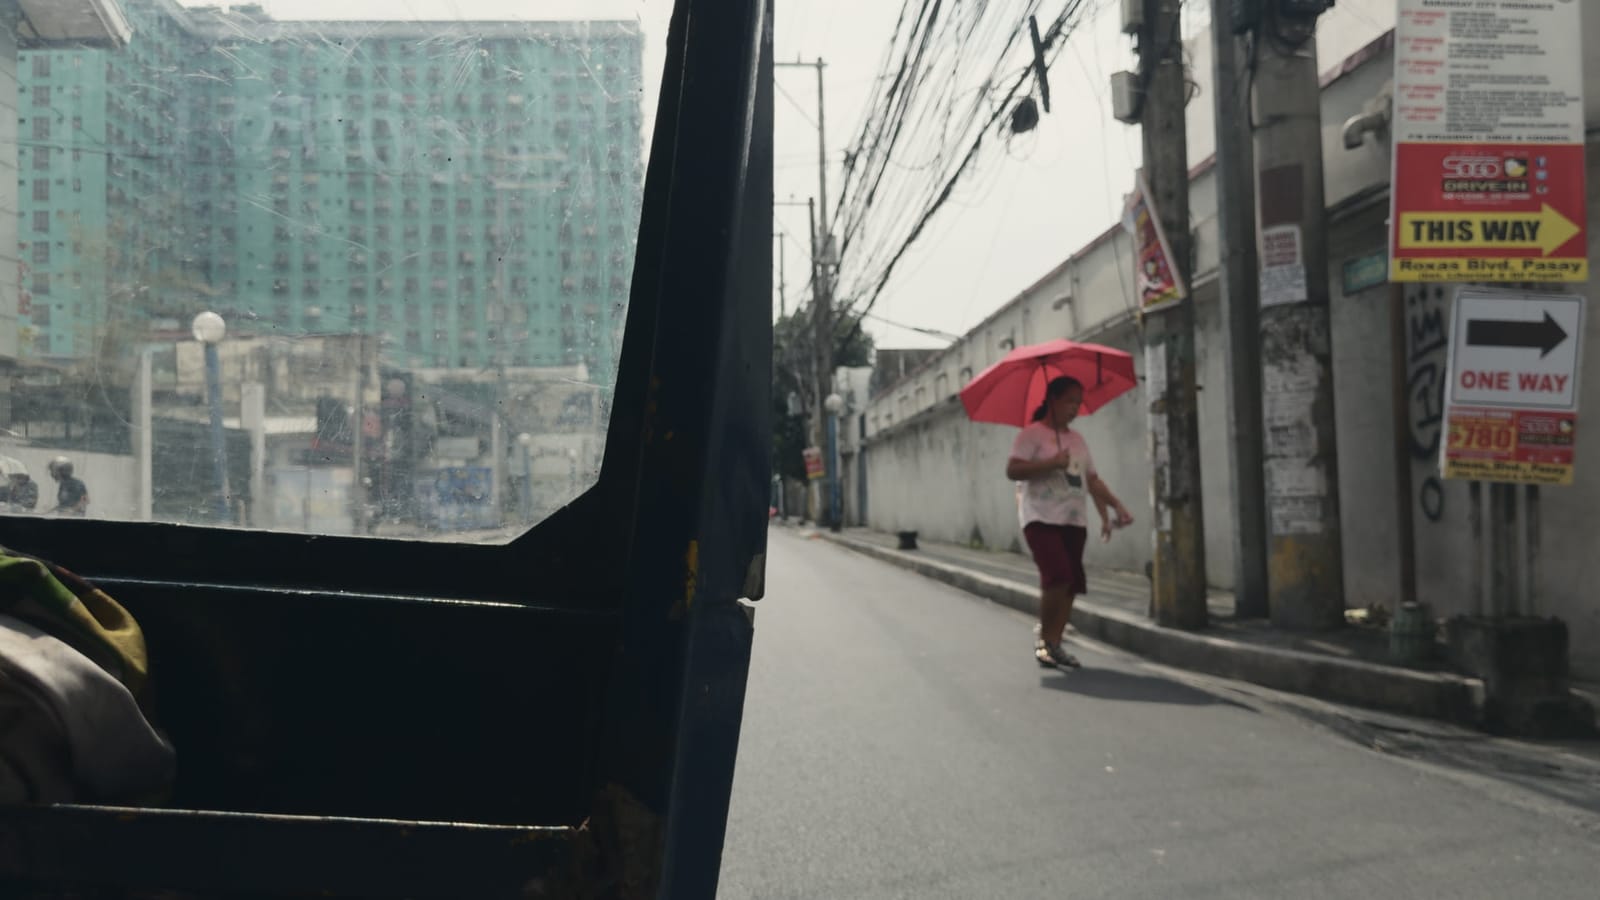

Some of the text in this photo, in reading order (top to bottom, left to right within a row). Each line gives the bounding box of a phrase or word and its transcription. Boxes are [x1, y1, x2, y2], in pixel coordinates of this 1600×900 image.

[1443, 180, 1527, 192] DRIVE-IN
[1410, 220, 1541, 241] THIS WAY
[1400, 260, 1459, 271] Roxas
[1523, 260, 1581, 273] Pasay
[1460, 370, 1569, 394] ONE WAY
